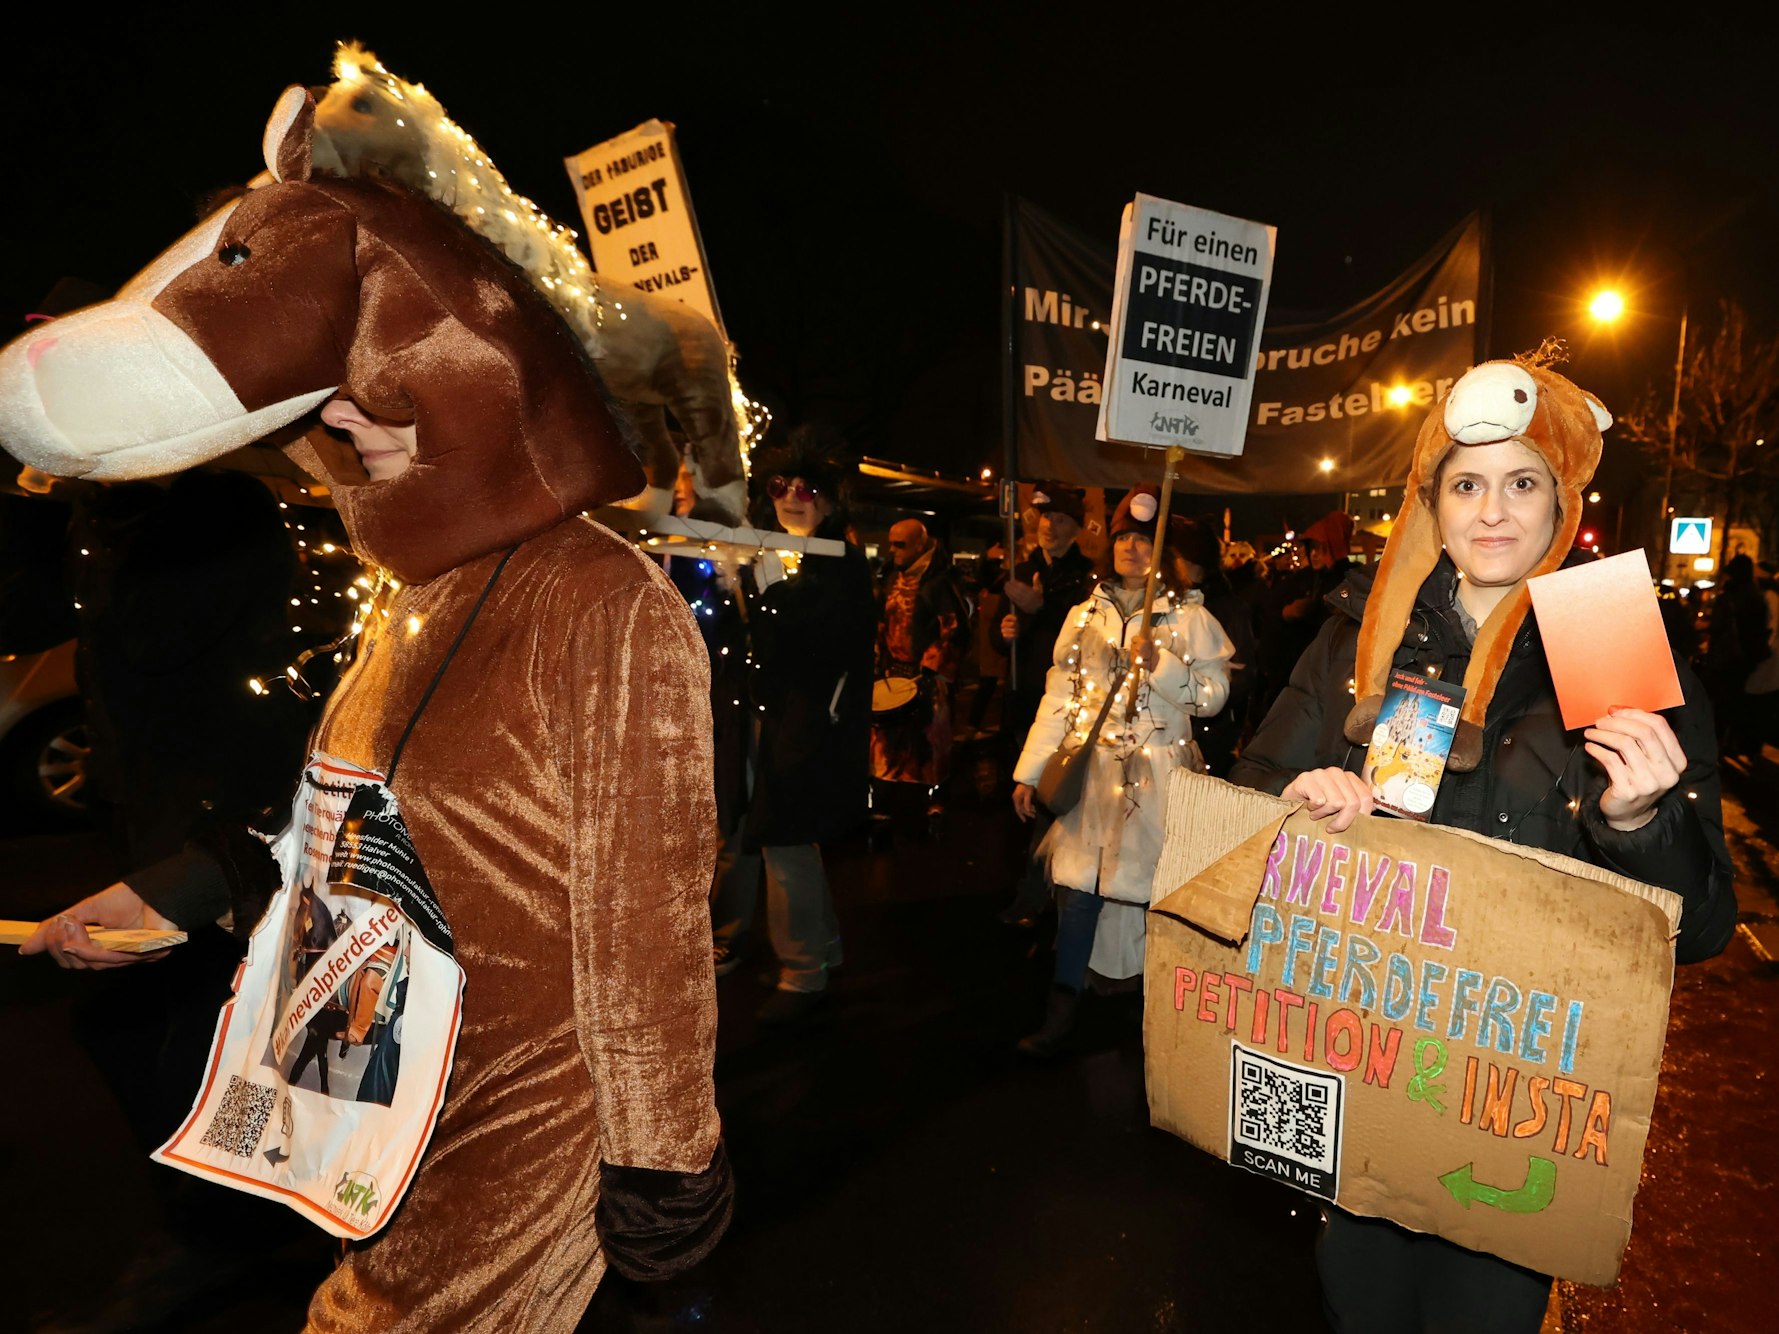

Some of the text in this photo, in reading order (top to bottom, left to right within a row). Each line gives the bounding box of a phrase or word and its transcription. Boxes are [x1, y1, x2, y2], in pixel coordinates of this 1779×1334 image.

[593, 177, 668, 235] GEIST
[629, 241, 660, 268] DER
[1147, 216, 1257, 265] Für einen
[1024, 286, 1090, 329] Mir
[1390, 296, 1476, 340] kein
[1139, 265, 1252, 314] PFERDE-
[1140, 320, 1236, 365] FREIEN
[1131, 370, 1232, 408] Karneval
[361, 844, 391, 858] Halver
[1246, 902, 1585, 1075] PFERDEFREI
[1174, 966, 1613, 1168] PETITION & INSTA
[1244, 1150, 1321, 1189] SCAN ME
